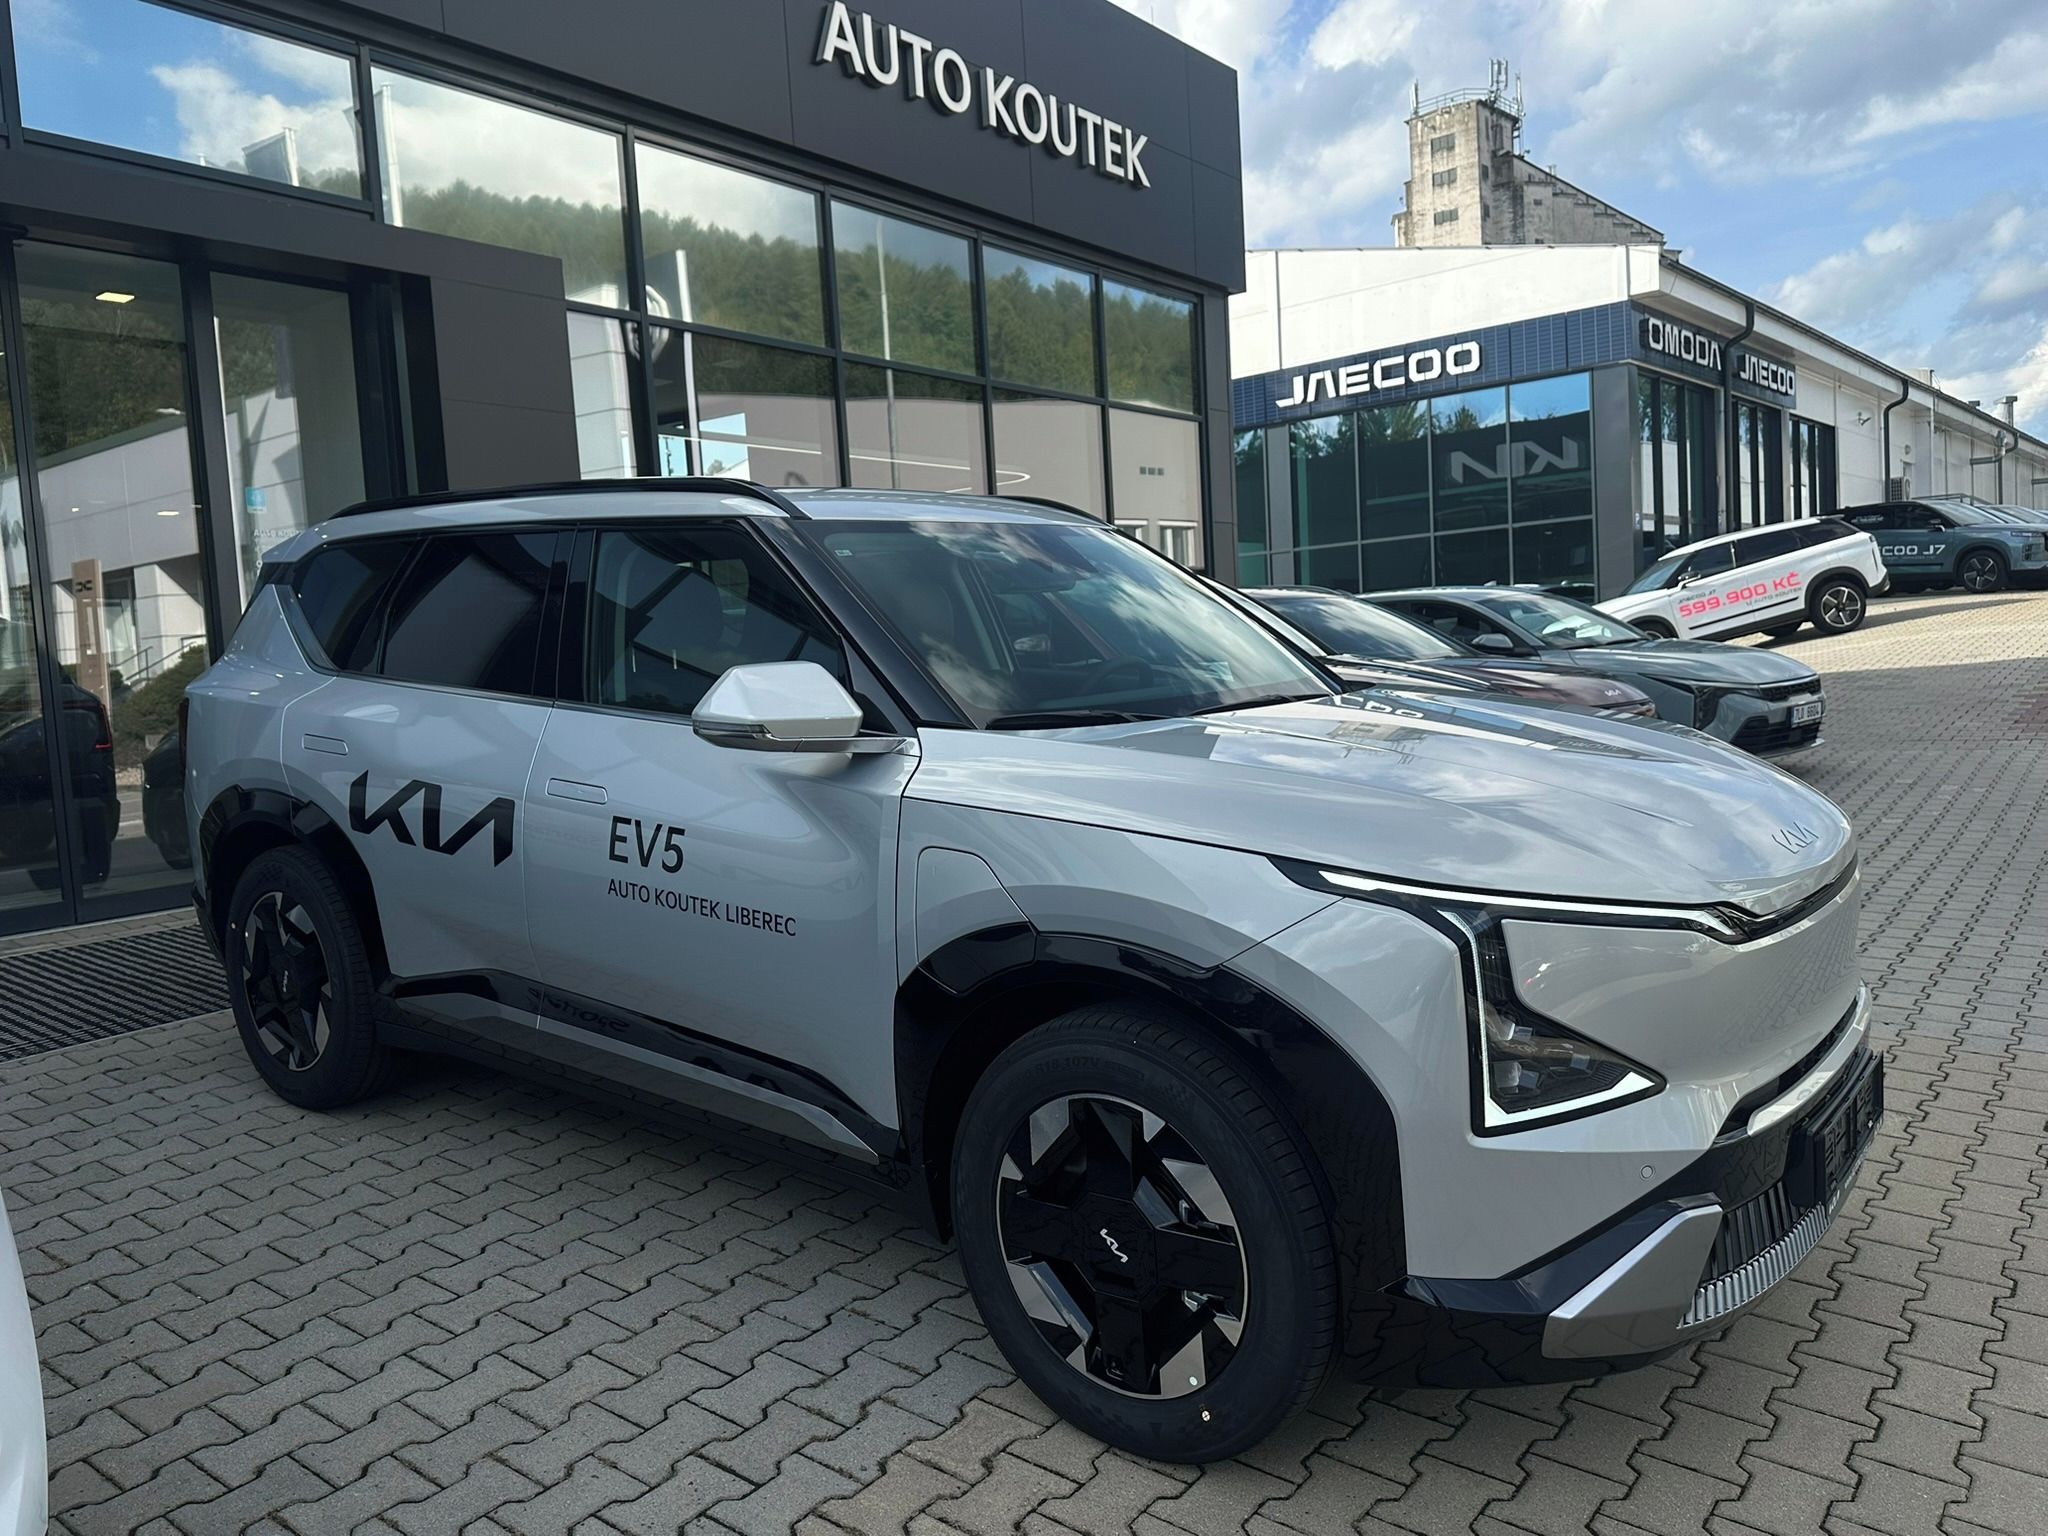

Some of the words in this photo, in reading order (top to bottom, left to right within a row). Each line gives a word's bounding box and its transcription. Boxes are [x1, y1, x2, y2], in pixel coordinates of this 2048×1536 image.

[814, 0, 972, 114] AUTO
[977, 66, 1151, 189] KOUTEK
[1646, 316, 1722, 372] OMODA
[1275, 340, 1481, 408] JAECOO
[1739, 353, 1795, 396] JAECOO
[1922, 544, 1946, 555] J7
[1679, 580, 1768, 618] 599.900
[1772, 571, 1802, 592] KČ
[349, 769, 515, 868] KIA
[608, 815, 686, 874] EV5
[608, 878, 650, 903] AUTO
[654, 887, 722, 921] KOUTEK
[725, 902, 797, 938] LIBEREC
